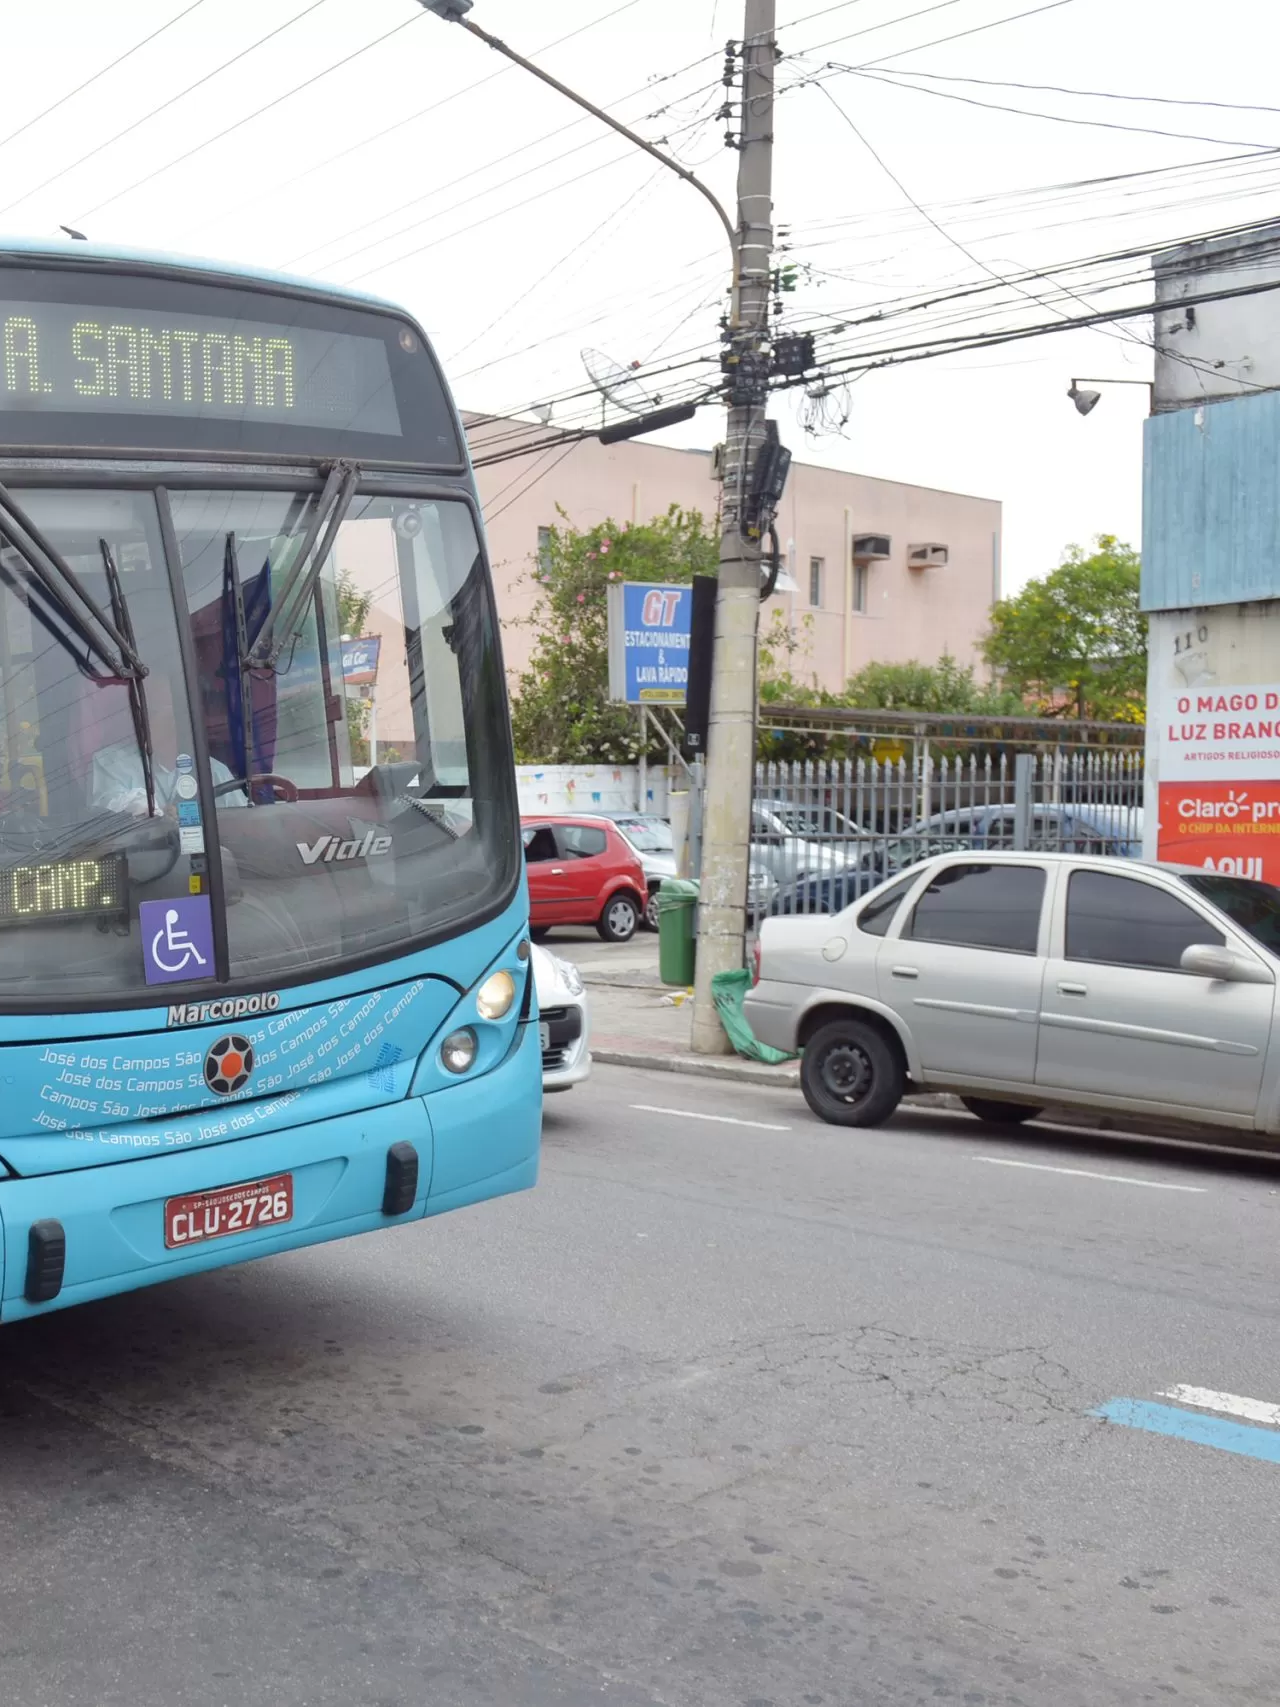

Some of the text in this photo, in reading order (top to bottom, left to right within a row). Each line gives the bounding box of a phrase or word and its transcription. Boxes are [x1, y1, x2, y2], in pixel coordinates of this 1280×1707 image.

[5, 317, 53, 392] A.
[72, 322, 294, 407] SANTANA
[642, 590, 681, 626] GT
[625, 631, 691, 649] ESTACIONAMENT
[1173, 626, 1209, 656] 110
[636, 667, 657, 683] LAVA
[1178, 697, 1190, 714] O
[1197, 693, 1258, 713] MAGO
[1168, 724, 1207, 741] LUZ
[1184, 752, 1225, 761] ARTIGOS
[1178, 797, 1280, 823] Claro pr
[1188, 823, 1213, 833] CHIP
[1215, 823, 1231, 833] DA
[296, 830, 393, 865] Viale
[13, 861, 111, 913] CAMP.
[167, 993, 280, 1027] Marcopolo
[40, 1048, 76, 1066] José
[80, 1055, 108, 1070] dos
[112, 1056, 170, 1072] Campos
[175, 1051, 202, 1067] São
[267, 1007, 312, 1036] Campo
[40, 1084, 99, 1111] Campos
[101, 1100, 129, 1117] São
[132, 1103, 167, 1118] José
[257, 1073, 282, 1093] São
[286, 1052, 315, 1079] José
[317, 1036, 339, 1057] dos
[339, 991, 382, 1038] Campos
[56, 1068, 91, 1087] José
[96, 1075, 122, 1091] dos
[127, 1077, 184, 1093] Campos
[188, 1073, 206, 1087] Sã
[254, 1049, 278, 1069] dos
[280, 1016, 328, 1055] Campos
[32, 1109, 67, 1131] José
[99, 1131, 160, 1147] Campos
[164, 1131, 193, 1145] São
[198, 1121, 228, 1141] José
[231, 1113, 256, 1130] dos
[254, 1089, 301, 1119] Campos
[363, 1022, 384, 1046] dos
[384, 979, 424, 1025] Campos
